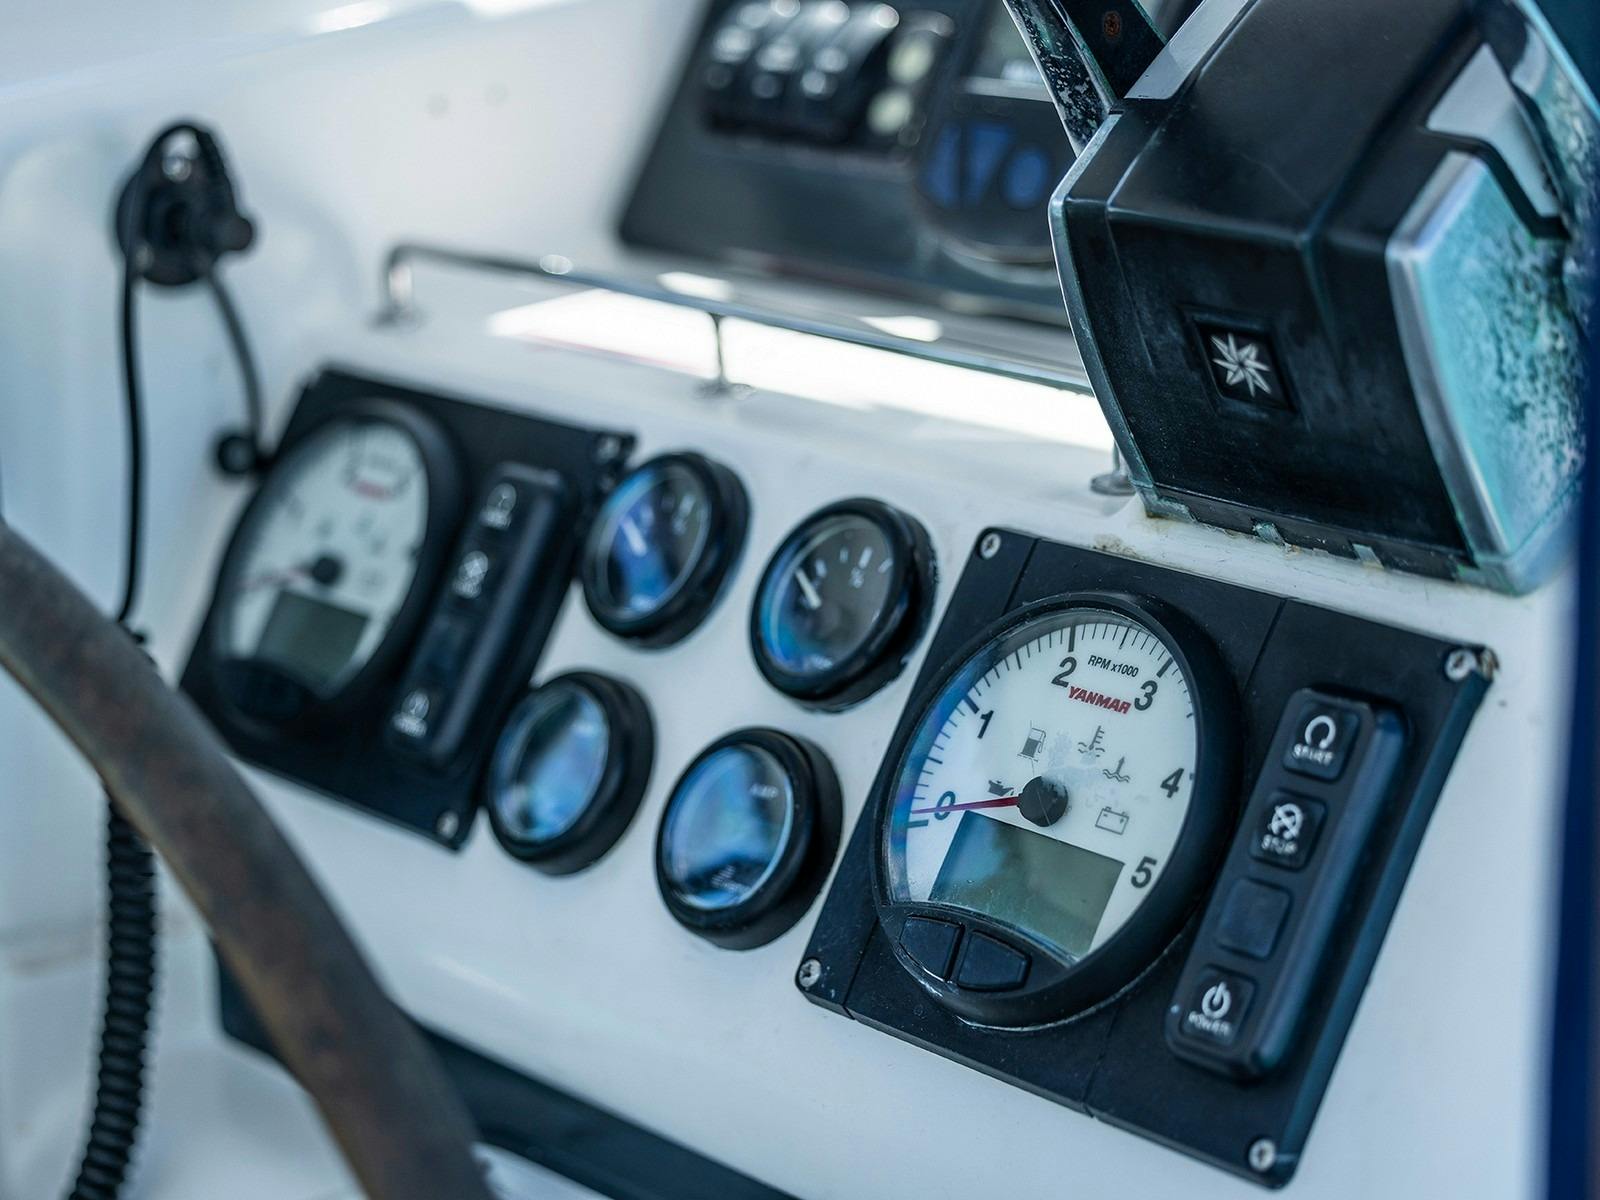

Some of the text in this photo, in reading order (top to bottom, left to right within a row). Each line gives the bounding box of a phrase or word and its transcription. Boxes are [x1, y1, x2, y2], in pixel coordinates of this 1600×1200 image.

[1050, 656, 1077, 688] 2
[1087, 654, 1139, 678] RPM x1000
[1068, 686, 1132, 714] YANMAR
[1133, 680, 1159, 711] 3
[977, 709, 994, 739] 1
[1160, 768, 1184, 798] 4
[934, 790, 956, 821] 0
[1131, 855, 1158, 889] 5
